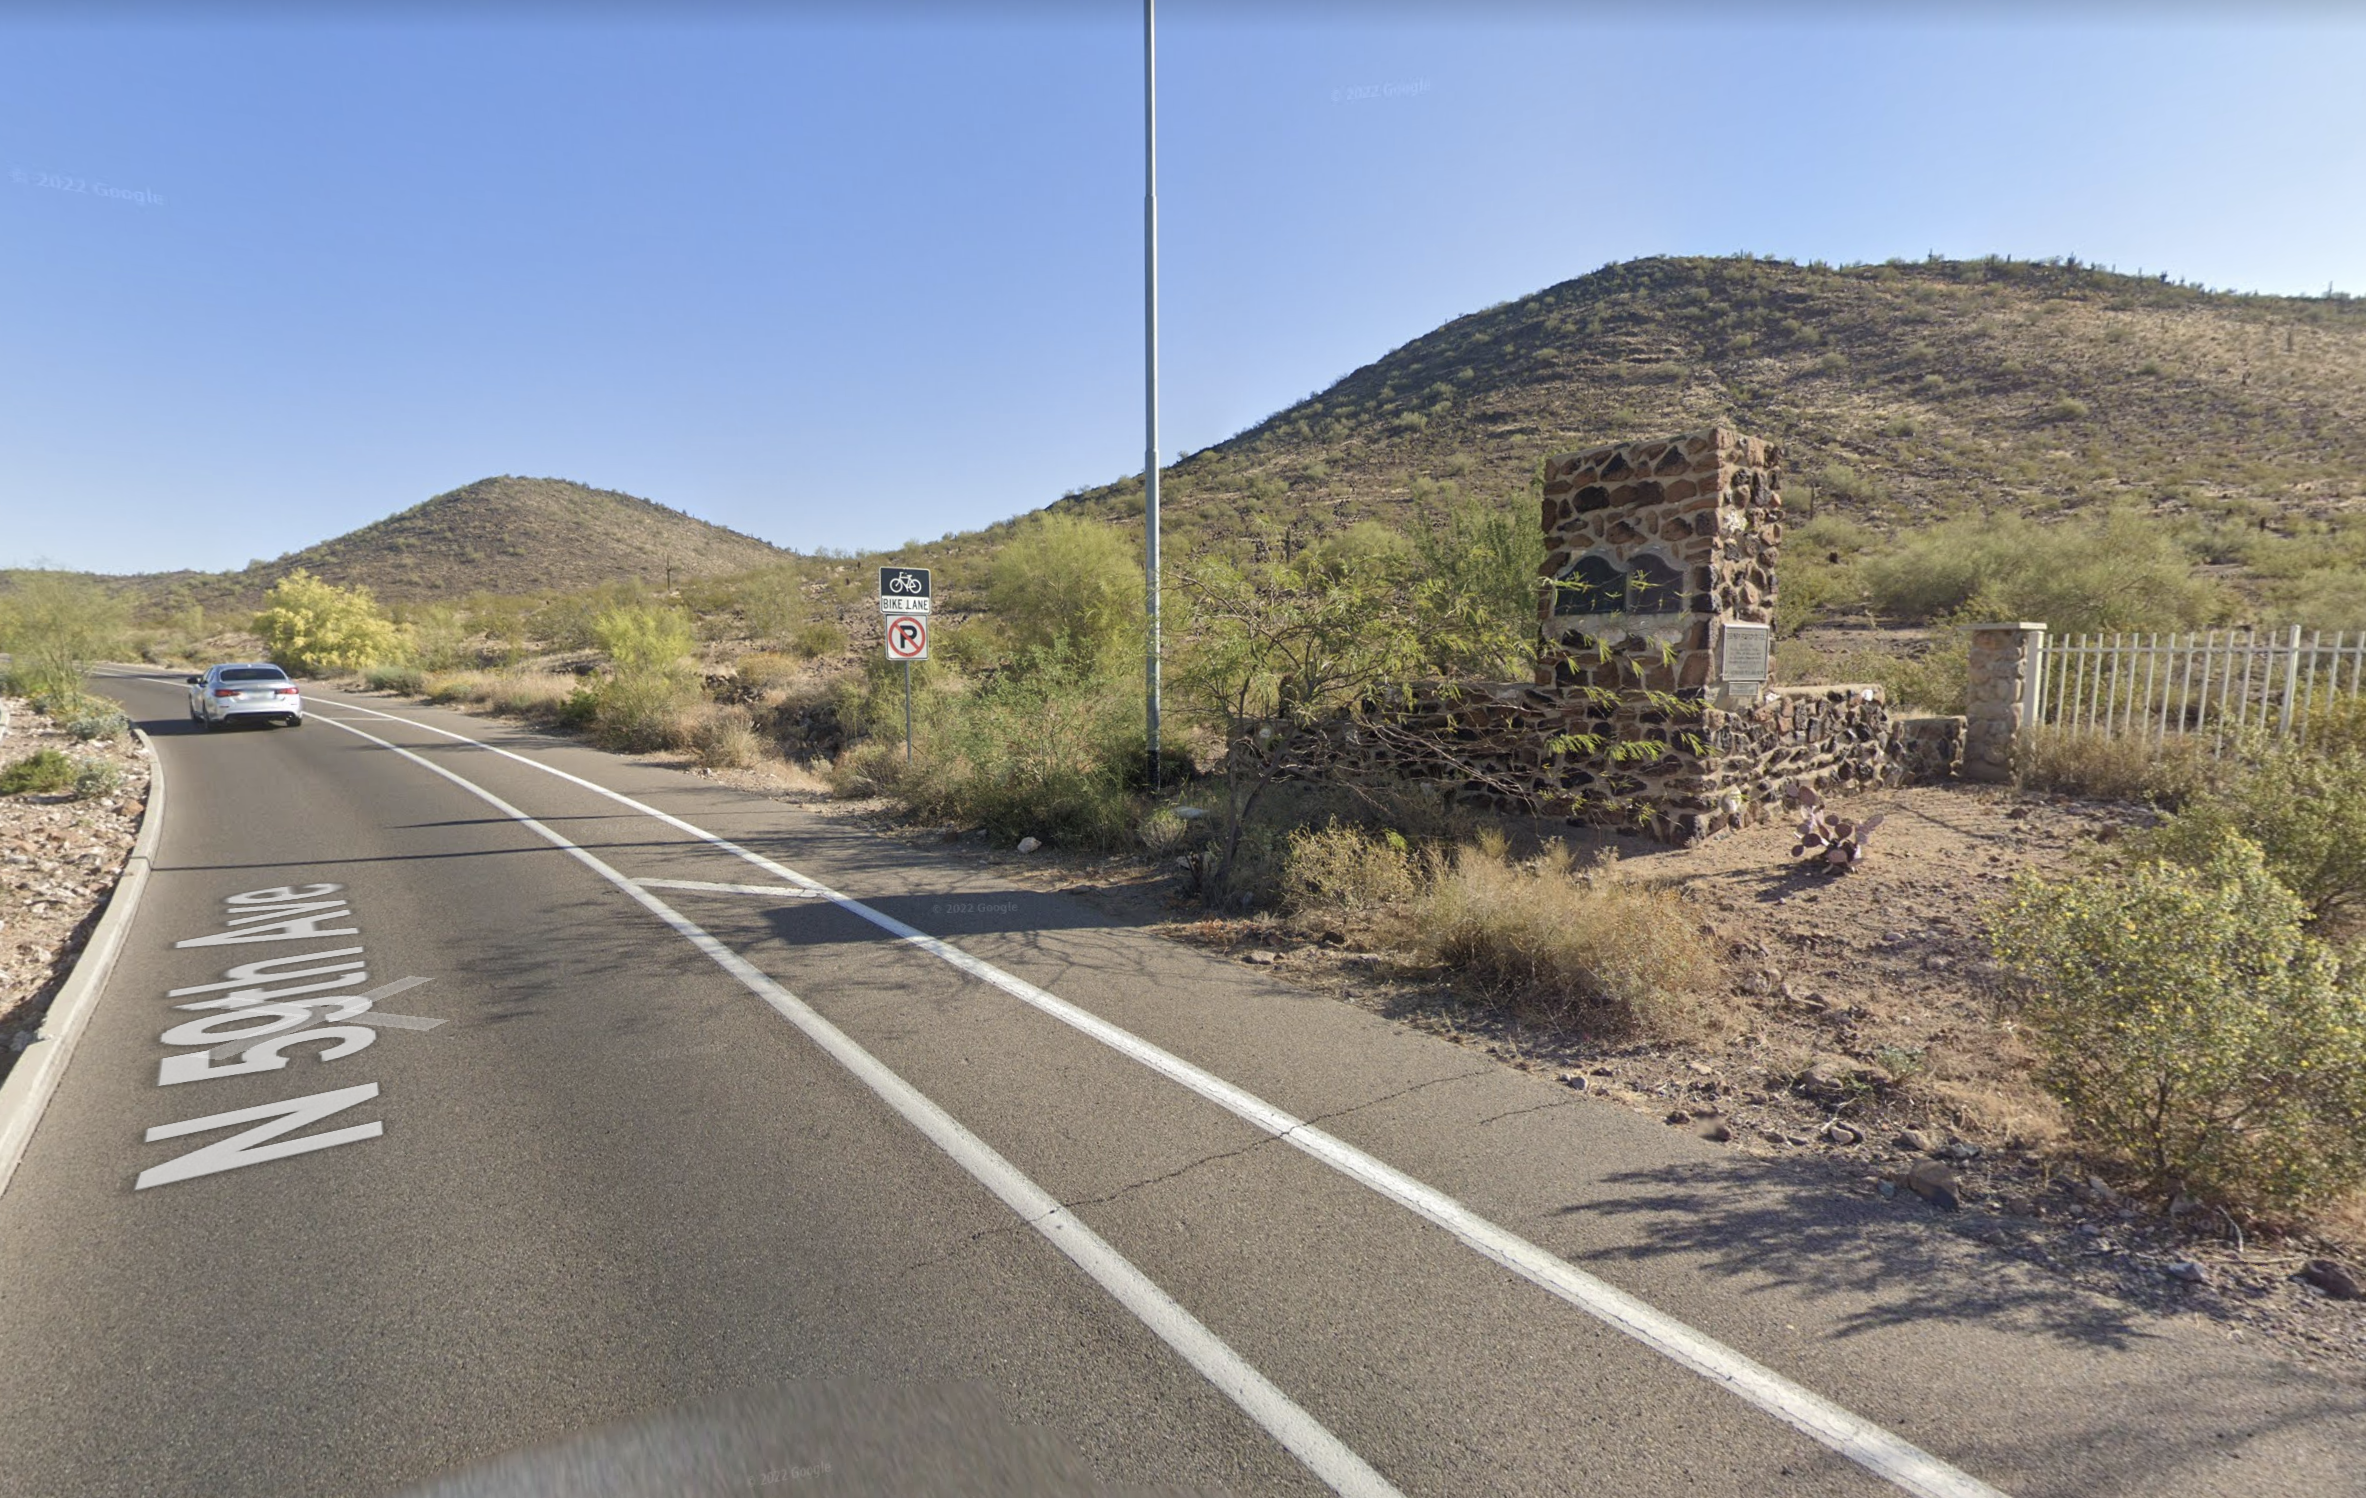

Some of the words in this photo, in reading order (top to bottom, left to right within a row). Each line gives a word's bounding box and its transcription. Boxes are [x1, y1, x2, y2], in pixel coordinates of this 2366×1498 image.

[883, 598, 903, 610] BIKE
[905, 599, 928, 611] LANE
[900, 625, 917, 649] P
